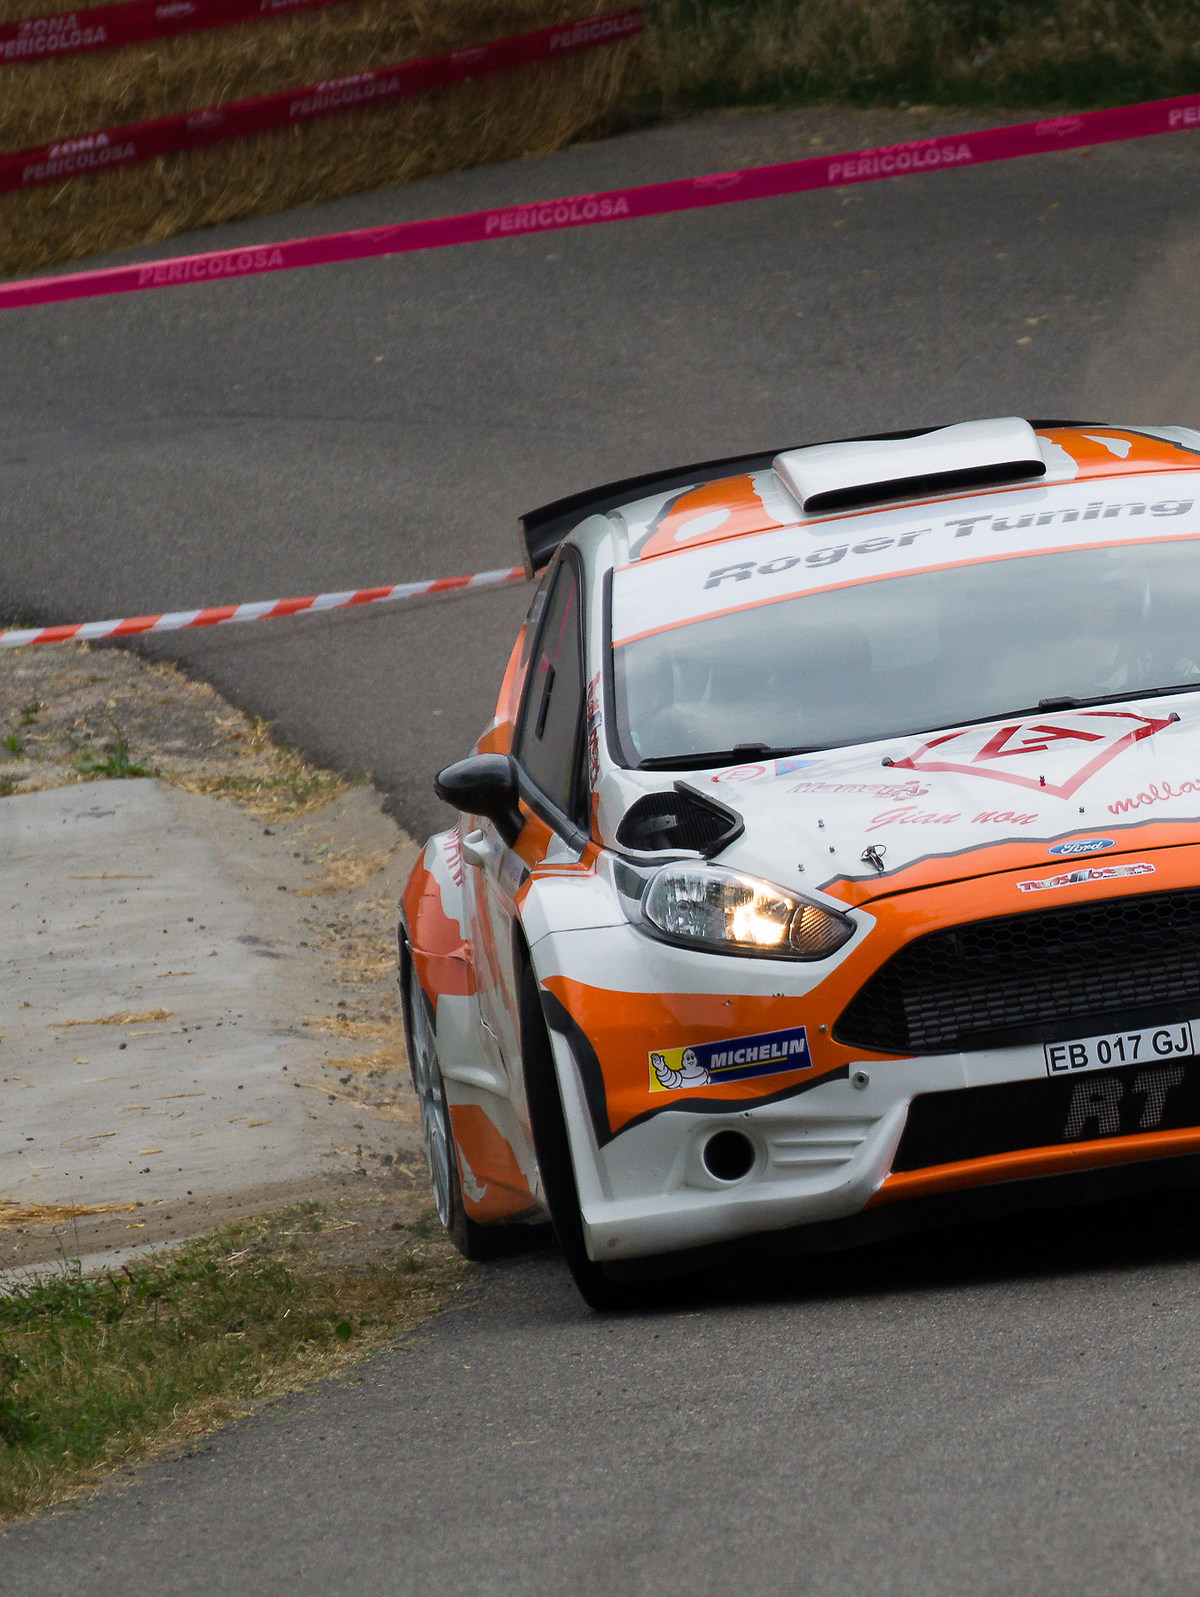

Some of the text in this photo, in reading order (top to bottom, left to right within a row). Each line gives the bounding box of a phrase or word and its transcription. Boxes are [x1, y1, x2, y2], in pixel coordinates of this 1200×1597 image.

[18, 14, 78, 37] ZONA
[288, 76, 400, 118] PERICOLOSA
[22, 142, 136, 184] PERICOLOSA
[827, 143, 972, 182] PERICOLOSA
[484, 197, 630, 235] PERICOLOSA
[137, 248, 284, 286] PERICOLOSA
[703, 498, 1195, 591] Roger Tuning
[970, 810, 1039, 826] non
[1060, 840, 1104, 854] Ford
[710, 1038, 805, 1069] MICHELIN
[1049, 1027, 1189, 1072] EB 017 GJ
